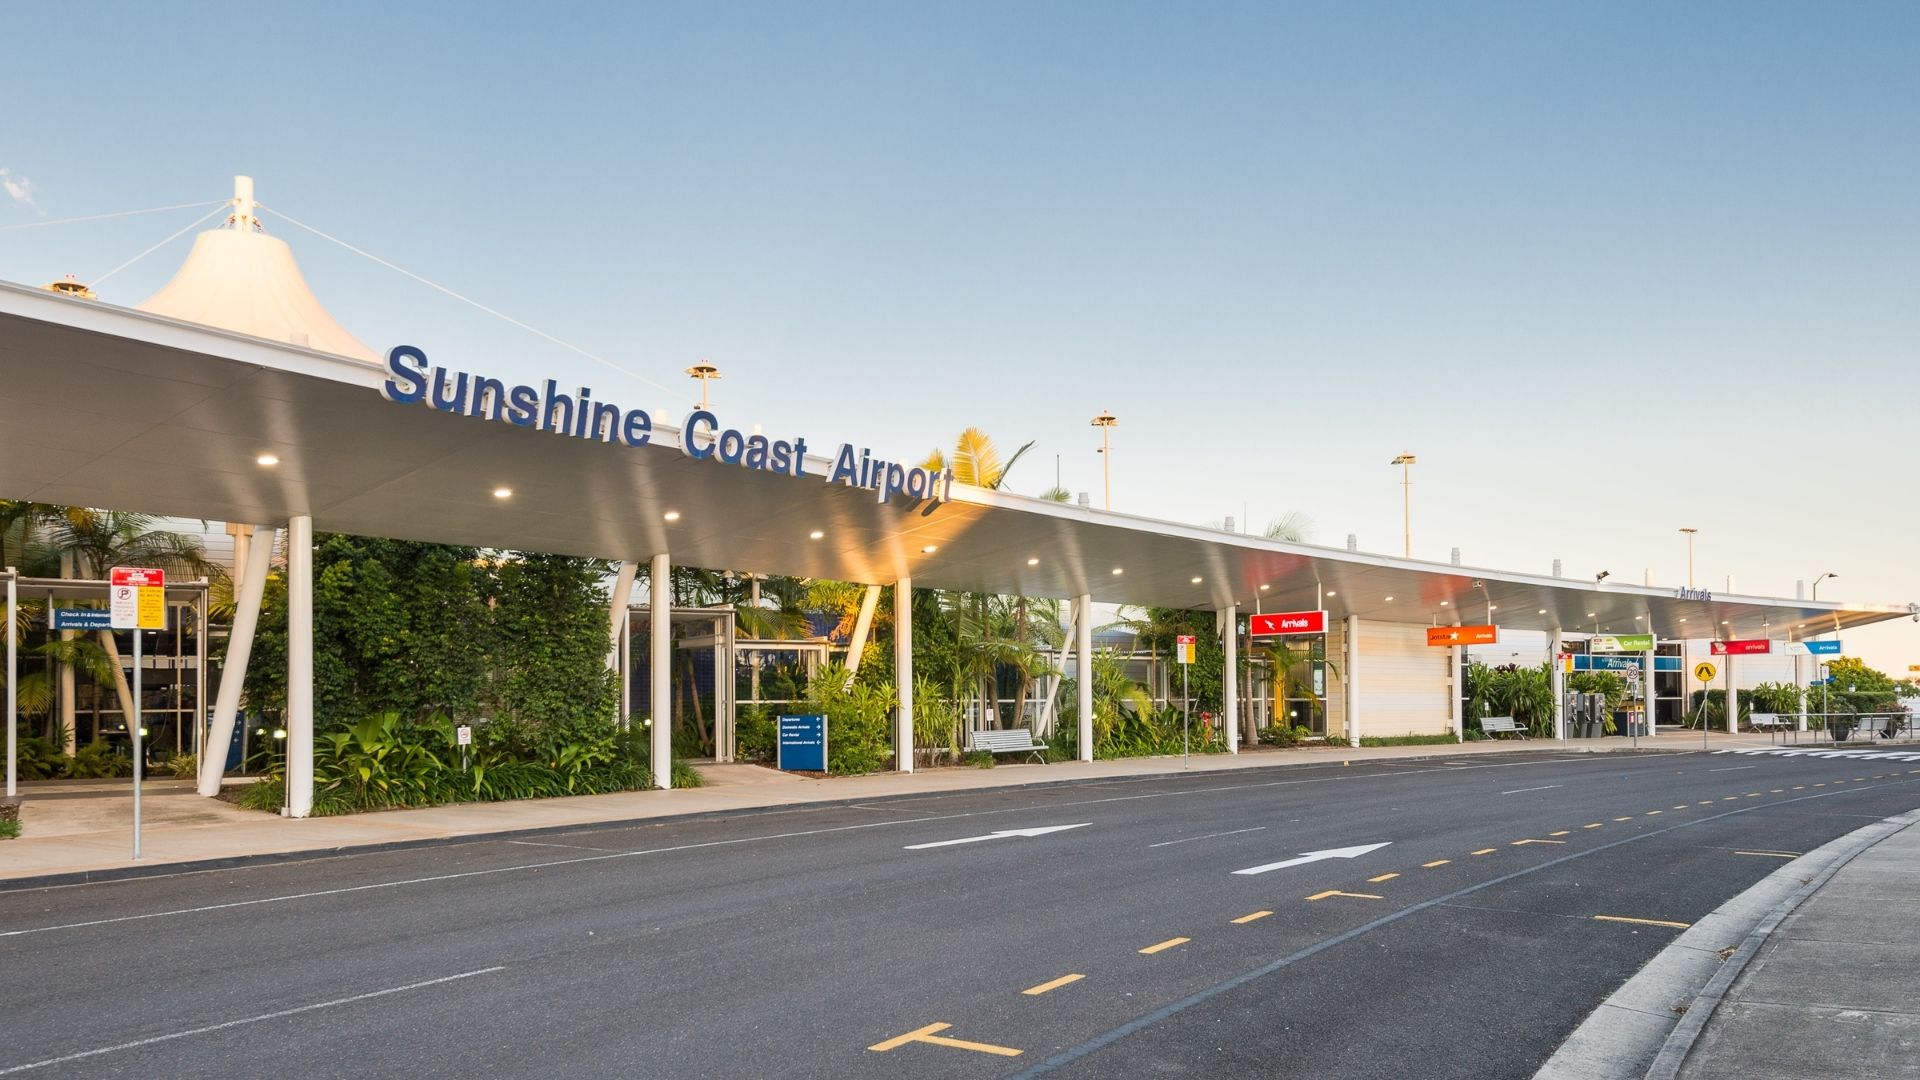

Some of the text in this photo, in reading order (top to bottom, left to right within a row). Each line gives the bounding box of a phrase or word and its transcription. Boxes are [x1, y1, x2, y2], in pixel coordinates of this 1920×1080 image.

[380, 345, 954, 503] Sunshine Coast Airport
[1680, 586, 1712, 601] Arrivals
[1281, 618, 1309, 629] Arrivals
[1628, 667, 1638, 676] 20
